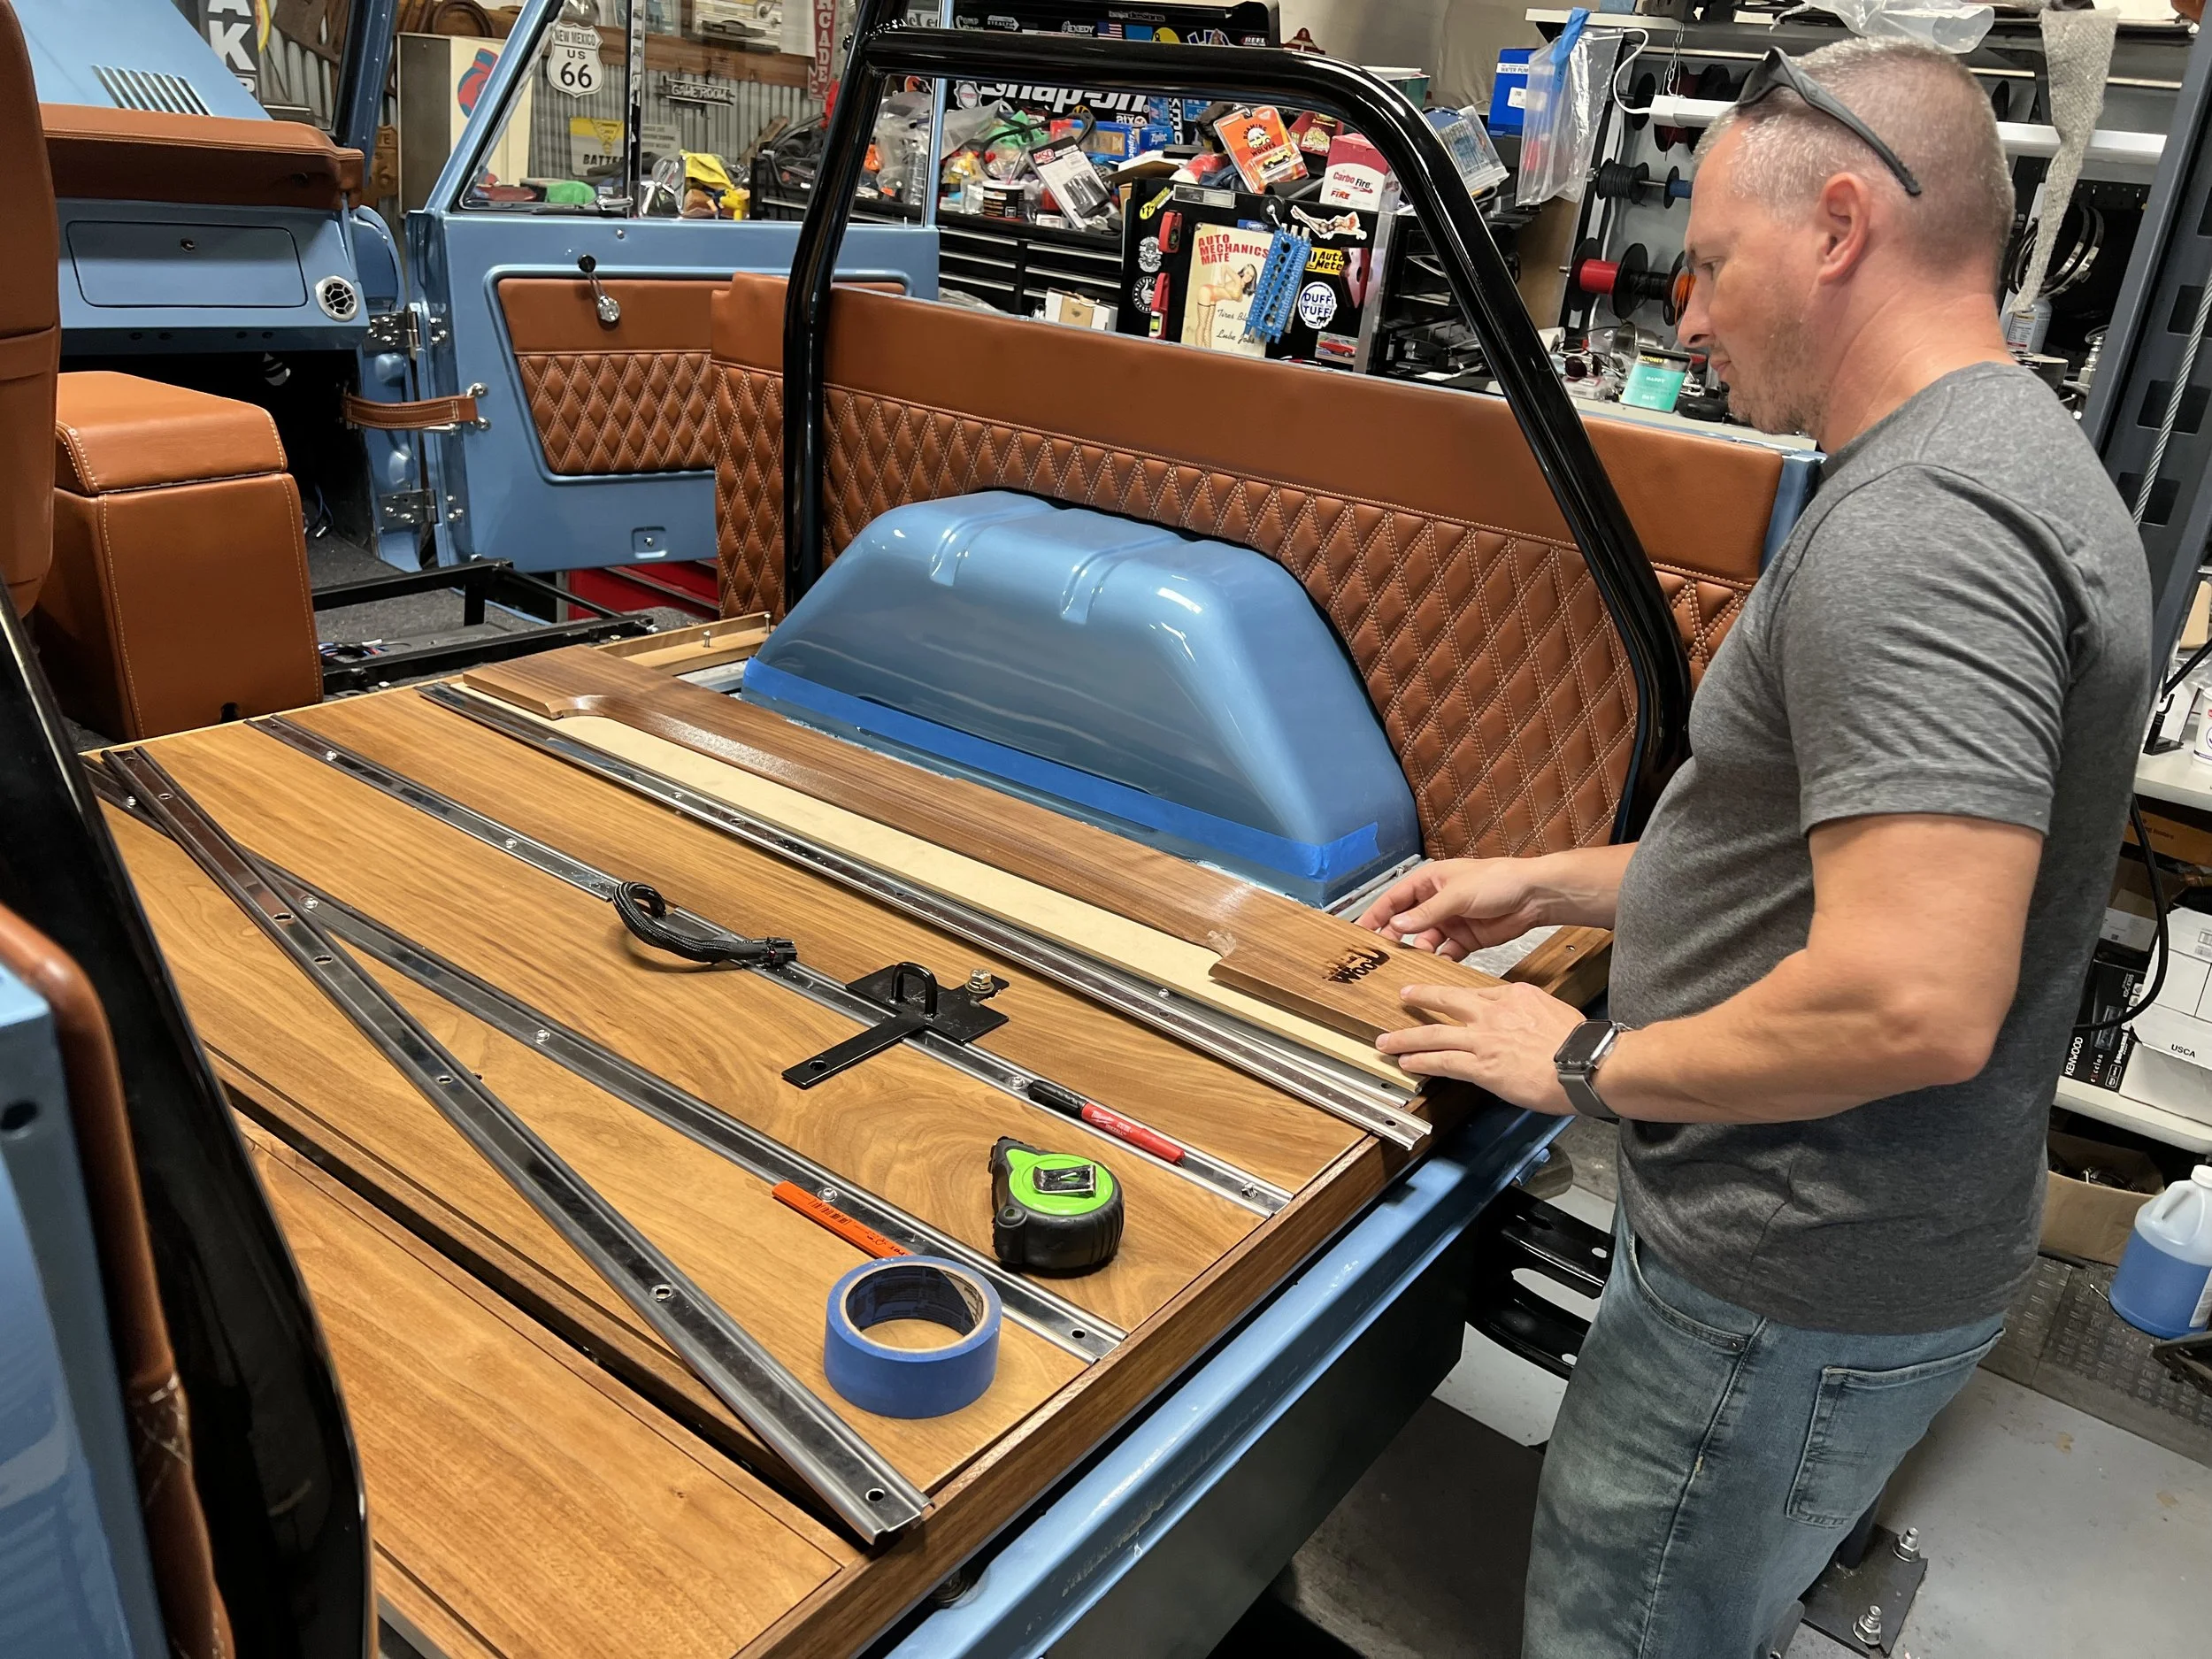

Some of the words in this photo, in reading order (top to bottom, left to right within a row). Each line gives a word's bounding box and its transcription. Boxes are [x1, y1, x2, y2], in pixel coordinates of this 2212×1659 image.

[1068, 25, 1094, 34] EXEDY
[555, 29, 571, 43] NEW
[571, 32, 596, 47] MEXICO
[566, 49, 587, 60] US
[560, 61, 593, 88] 66
[672, 84, 698, 98] GAME
[1243, 124, 1267, 139] ROAMING
[1034, 149, 1055, 161] MSD
[1251, 142, 1276, 157] WOLVES
[1333, 172, 1356, 184] Carbo
[1356, 178, 1371, 188] Fire
[1198, 234, 1230, 248] AUTO
[1199, 243, 1270, 258] MECHANICS
[1319, 251, 1344, 262] Auto
[1201, 252, 1230, 265] MATE
[1316, 259, 1342, 271] Mete
[1303, 293, 1332, 304] DUFF
[1217, 309, 1234, 319] Tires
[1303, 305, 1331, 317] TUFF
[1216, 329, 1236, 341] Lube
[2064, 1036, 2084, 1076] KENWOOD
[2170, 1043, 2196, 1058] USCA
